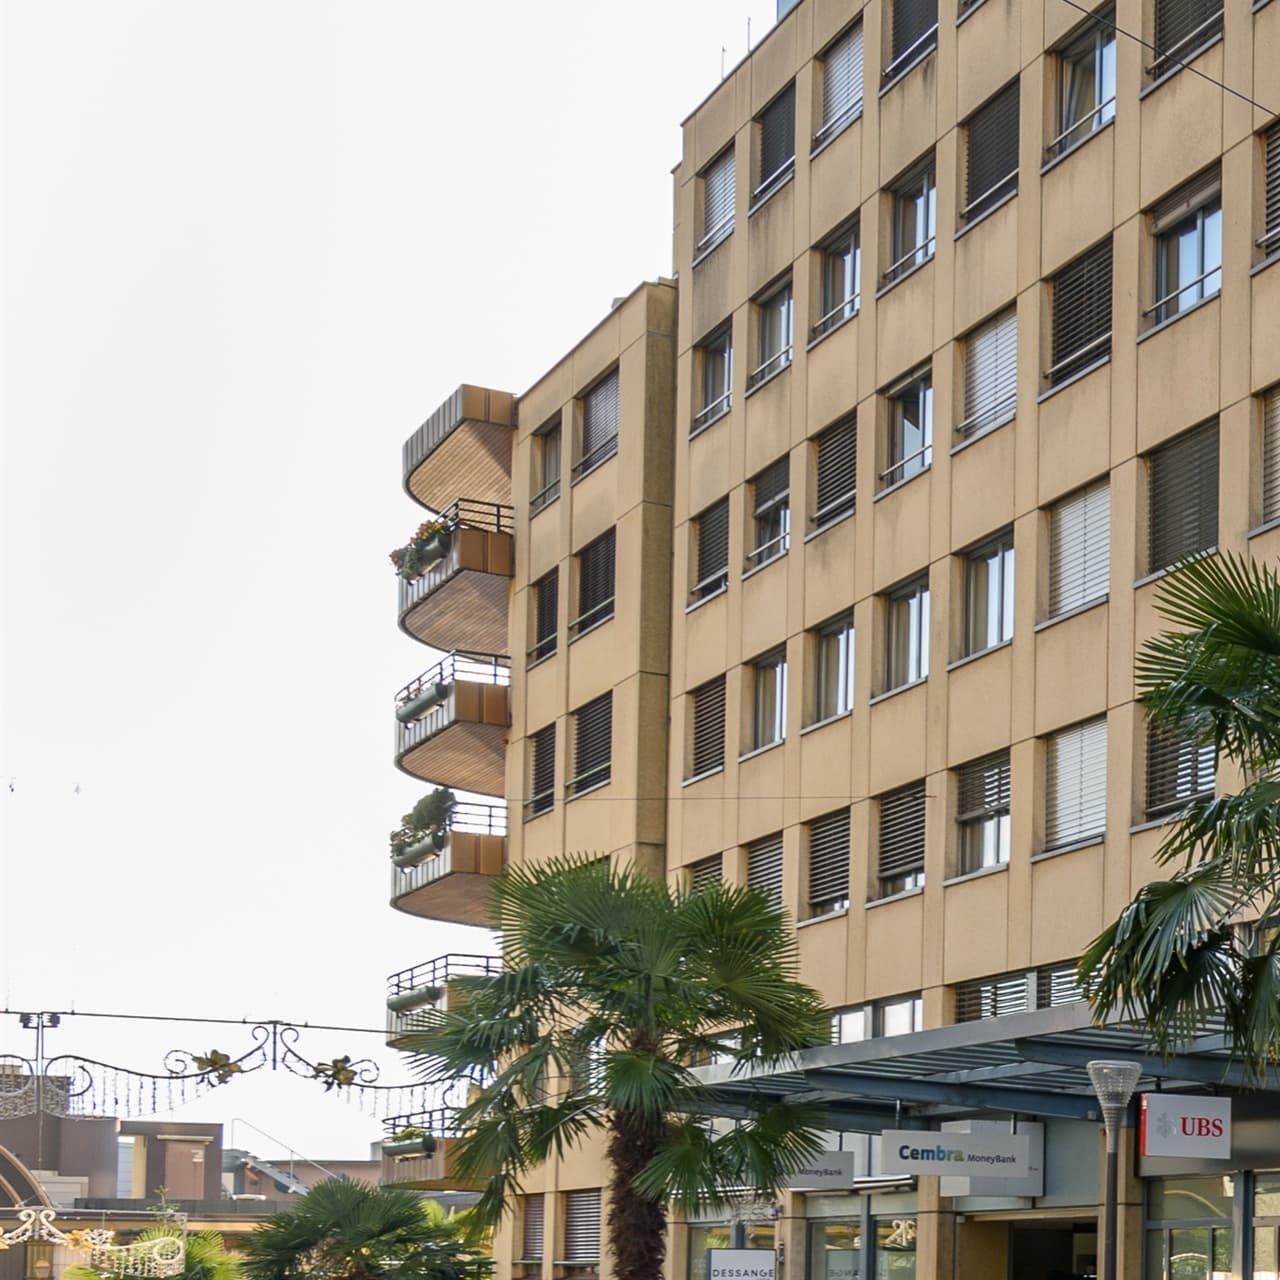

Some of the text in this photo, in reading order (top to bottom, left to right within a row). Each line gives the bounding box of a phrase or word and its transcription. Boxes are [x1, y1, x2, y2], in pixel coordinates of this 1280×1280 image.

[1180, 1116, 1223, 1137] UBS
[899, 1145, 1016, 1165] Cembra MoneyBank
[712, 1268, 774, 1277] DESSANGE
